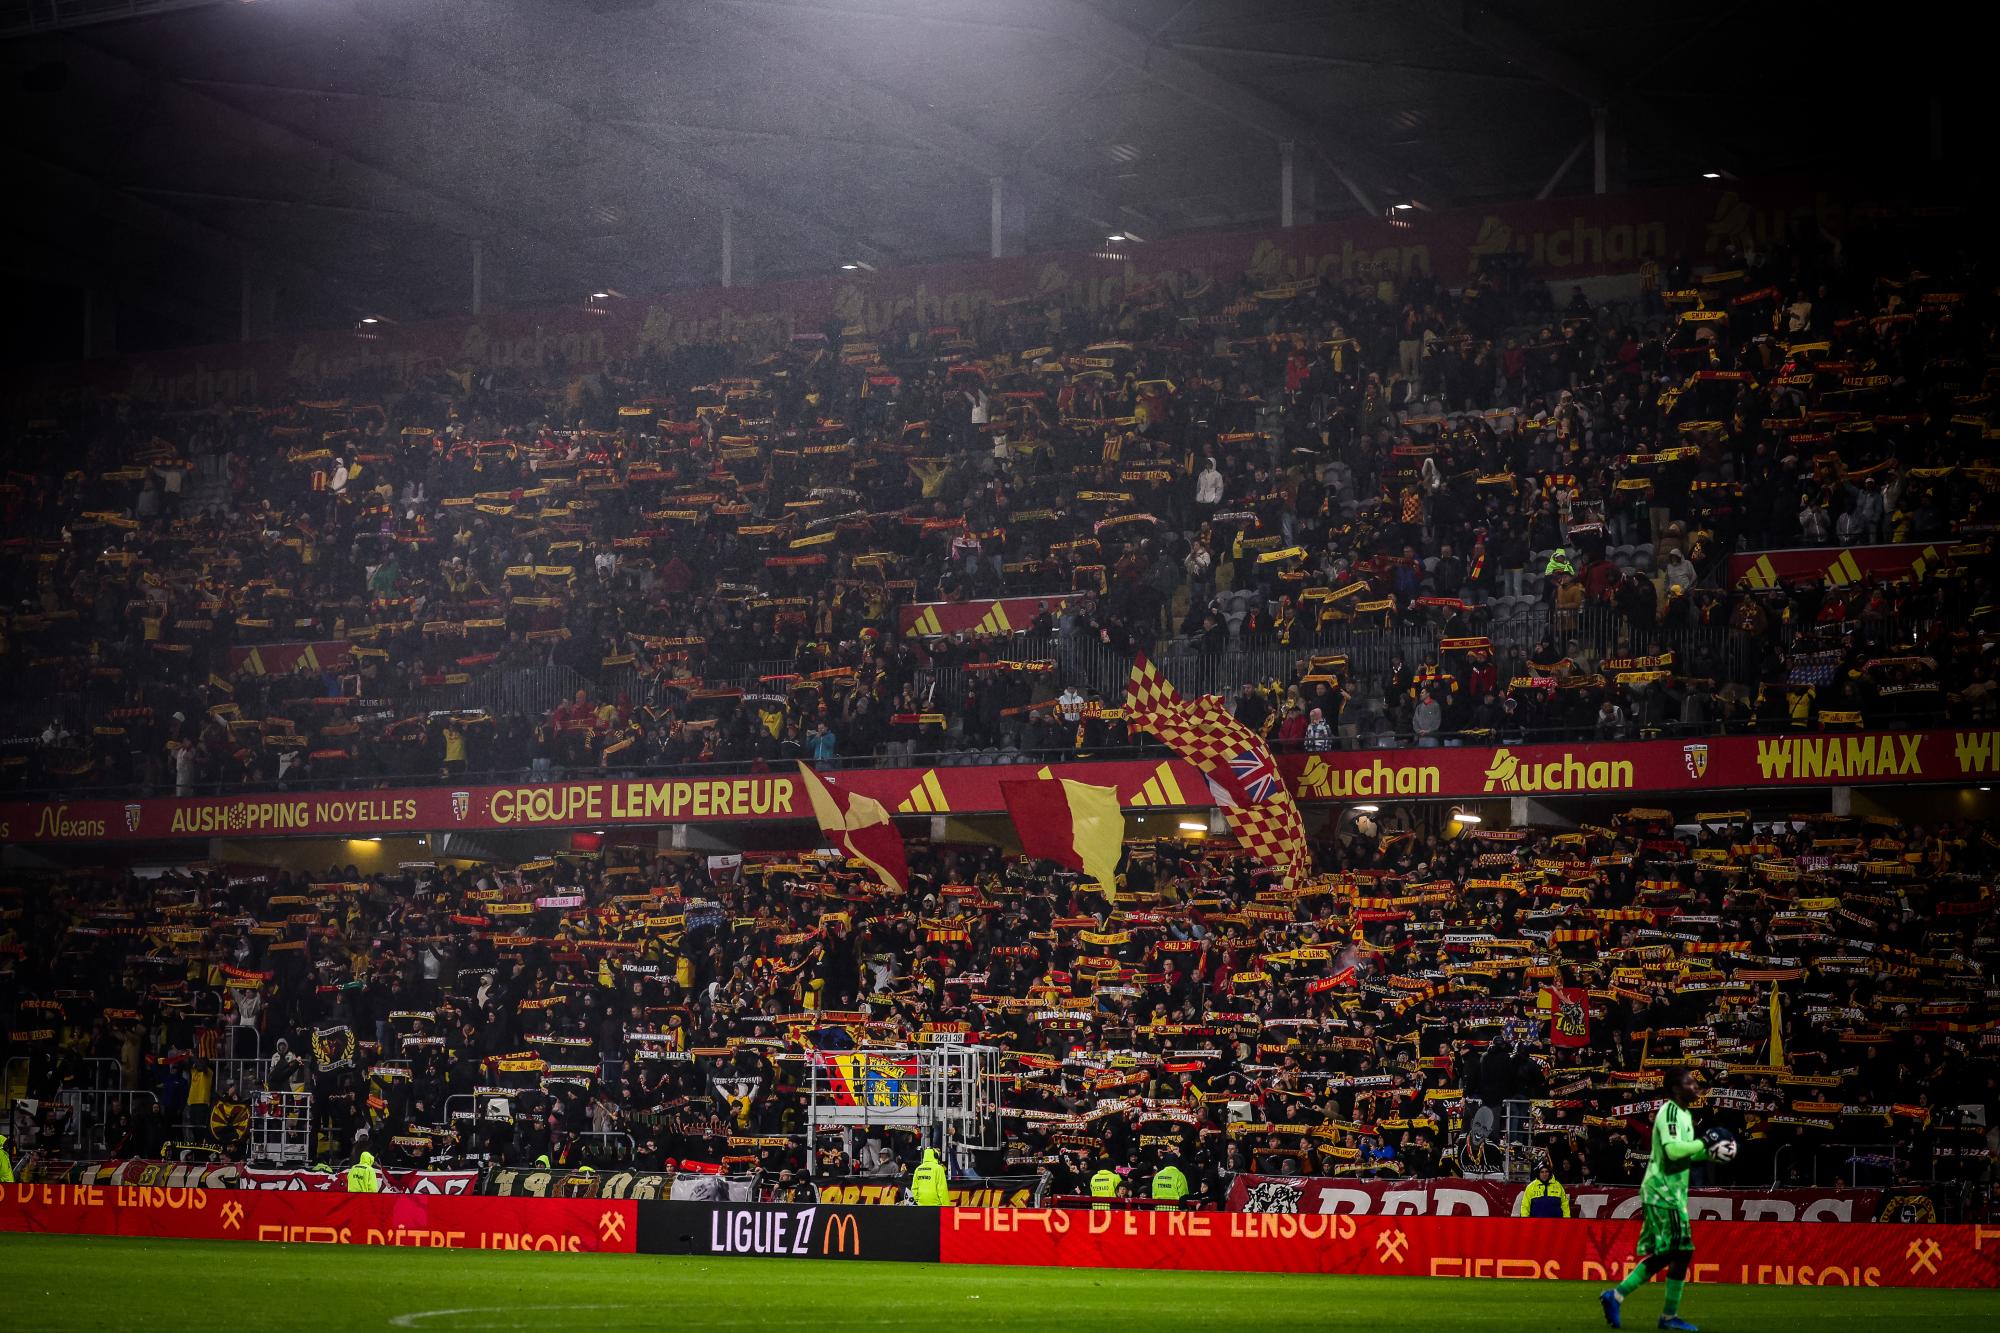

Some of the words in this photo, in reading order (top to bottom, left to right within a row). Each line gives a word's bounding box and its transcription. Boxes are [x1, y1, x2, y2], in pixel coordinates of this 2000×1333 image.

[1468, 216, 1666, 274] Auchan
[1777, 376, 1788, 384] RC
[1122, 471, 1140, 481] ALLEZ
[1609, 657, 1632, 668] ALLEZ
[1641, 655, 1662, 666] LENS
[1757, 734, 1924, 779] WINAMAX
[1484, 748, 1634, 792] Auchan
[1297, 754, 1441, 799] Auchan
[490, 785, 603, 824] GROUPE
[611, 778, 794, 818] LEMPEREUR
[28, 805, 105, 838] Nexans
[171, 801, 310, 833] AUSHOPPING
[315, 799, 417, 824] NOYELLES
[650, 917, 667, 926] ALLEZ
[1297, 950, 1307, 959] RC
[1308, 950, 1324, 959] LENS
[1236, 972, 1246, 982] RC
[1247, 971, 1263, 981] LENS
[1037, 1011, 1060, 1020] LENS
[1069, 1011, 1092, 1021] FANS
[532, 1034, 552, 1042] LENS
[505, 1051, 533, 1060] LENS
[1613, 1106, 1633, 1116] 19
[730, 1137, 752, 1145] ALLEZ
[763, 1137, 784, 1146] LENS
[819, 1184, 900, 1206] ORTH
[711, 1209, 788, 1254] LIGUE
